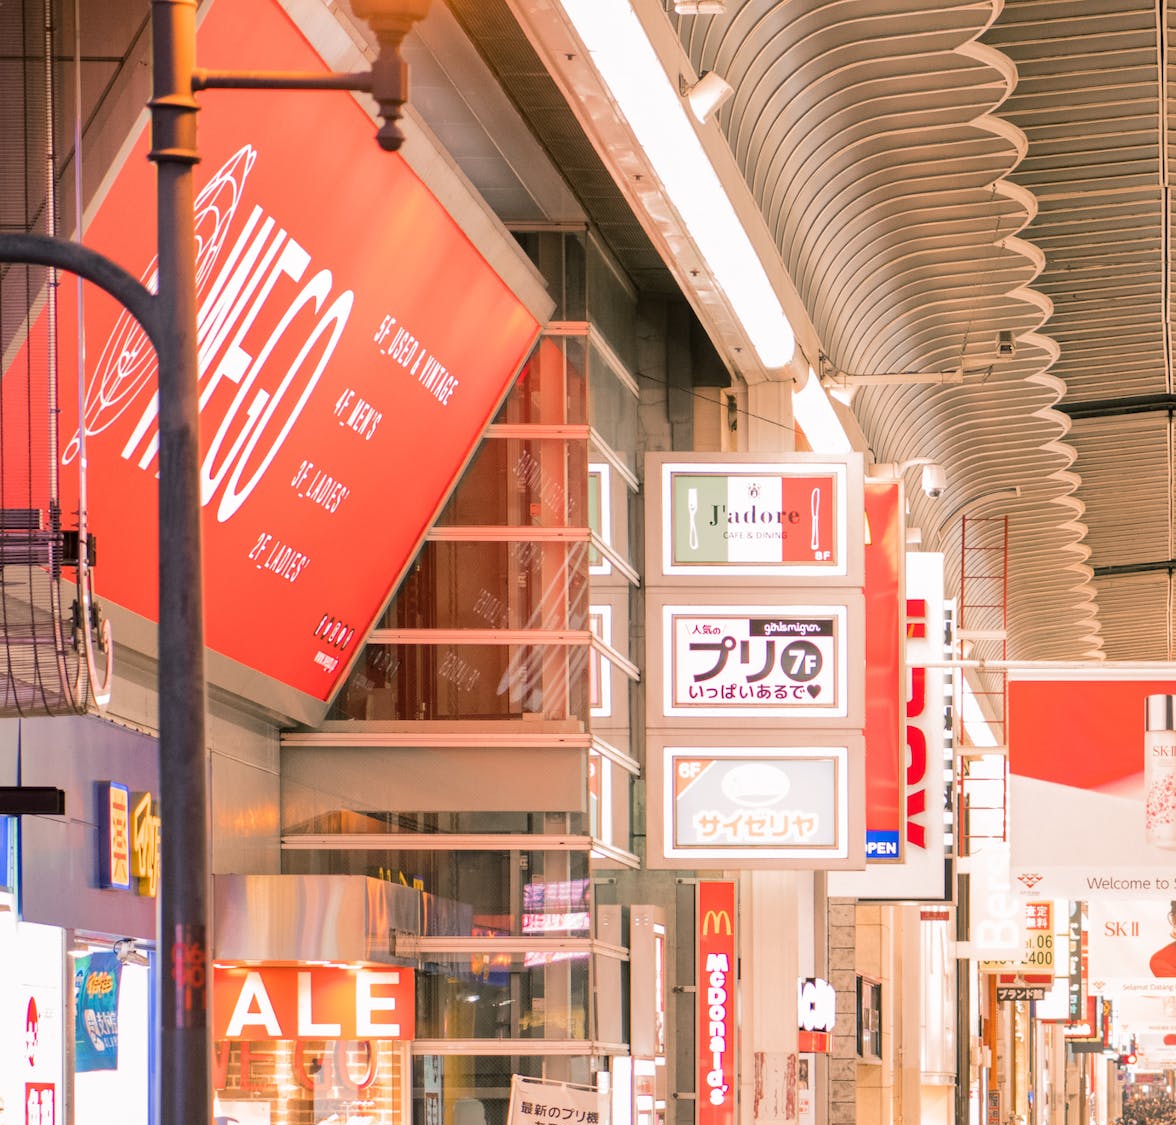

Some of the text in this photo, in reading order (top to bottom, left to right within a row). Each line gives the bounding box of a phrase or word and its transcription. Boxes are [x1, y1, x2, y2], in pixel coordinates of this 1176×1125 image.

[418, 355, 459, 406] VINTAGE
[709, 504, 801, 527] J'adore
[722, 531, 747, 540] CAFE
[756, 531, 788, 540] DINING
[814, 551, 831, 561] 8F
[692, 624, 721, 636] 人気の
[689, 636, 776, 684] プリ
[788, 649, 817, 675] 7F
[689, 684, 806, 700] いっぱいあるで
[678, 762, 701, 779] 6F
[866, 841, 897, 854] PEN
[1087, 877, 1151, 890] Welcome
[1155, 878, 1170, 890] to
[1036, 934, 1053, 949] 06
[226, 972, 400, 1037] ALE
[705, 953, 729, 1106] McDonald's
[520, 1101, 600, 1125] 最新のプリ機
